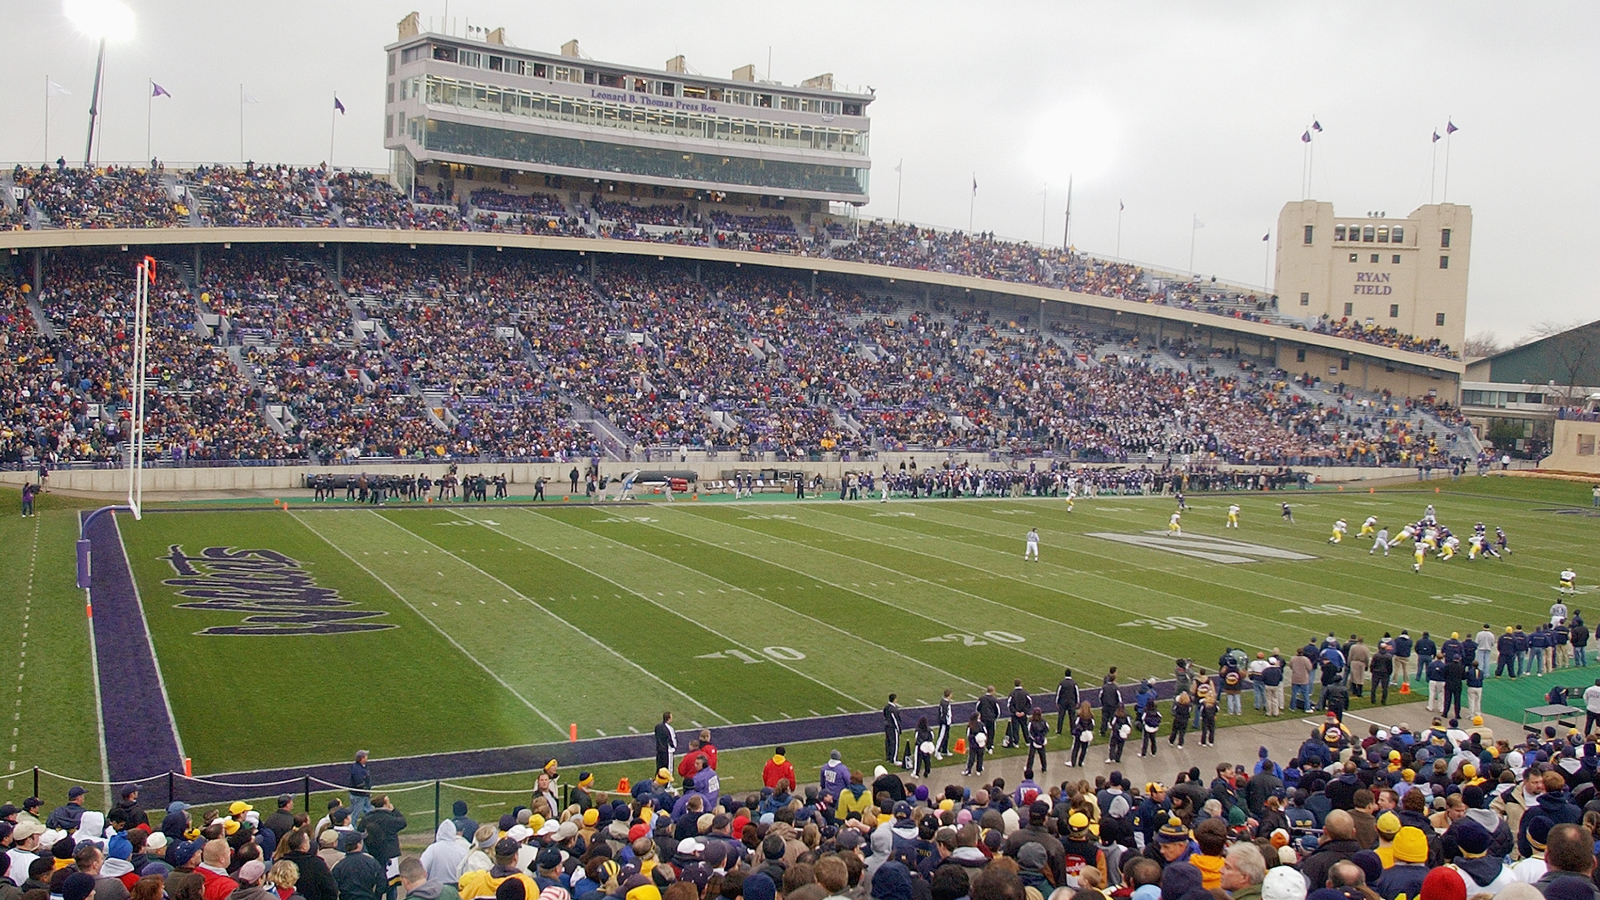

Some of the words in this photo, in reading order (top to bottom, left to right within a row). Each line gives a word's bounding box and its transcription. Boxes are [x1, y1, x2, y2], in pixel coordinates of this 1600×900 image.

[591, 89, 627, 103] Leonard
[628, 94, 638, 104] B.
[640, 95, 674, 109] Thomas
[675, 100, 699, 111] Press
[701, 104, 717, 114] Box
[1356, 272, 1391, 283] RYAN
[1353, 284, 1392, 296] FIELD
[1302, 604, 1361, 616] 40
[1132, 615, 1209, 631] 30
[943, 630, 1026, 647] 20
[725, 646, 806, 664] 10
